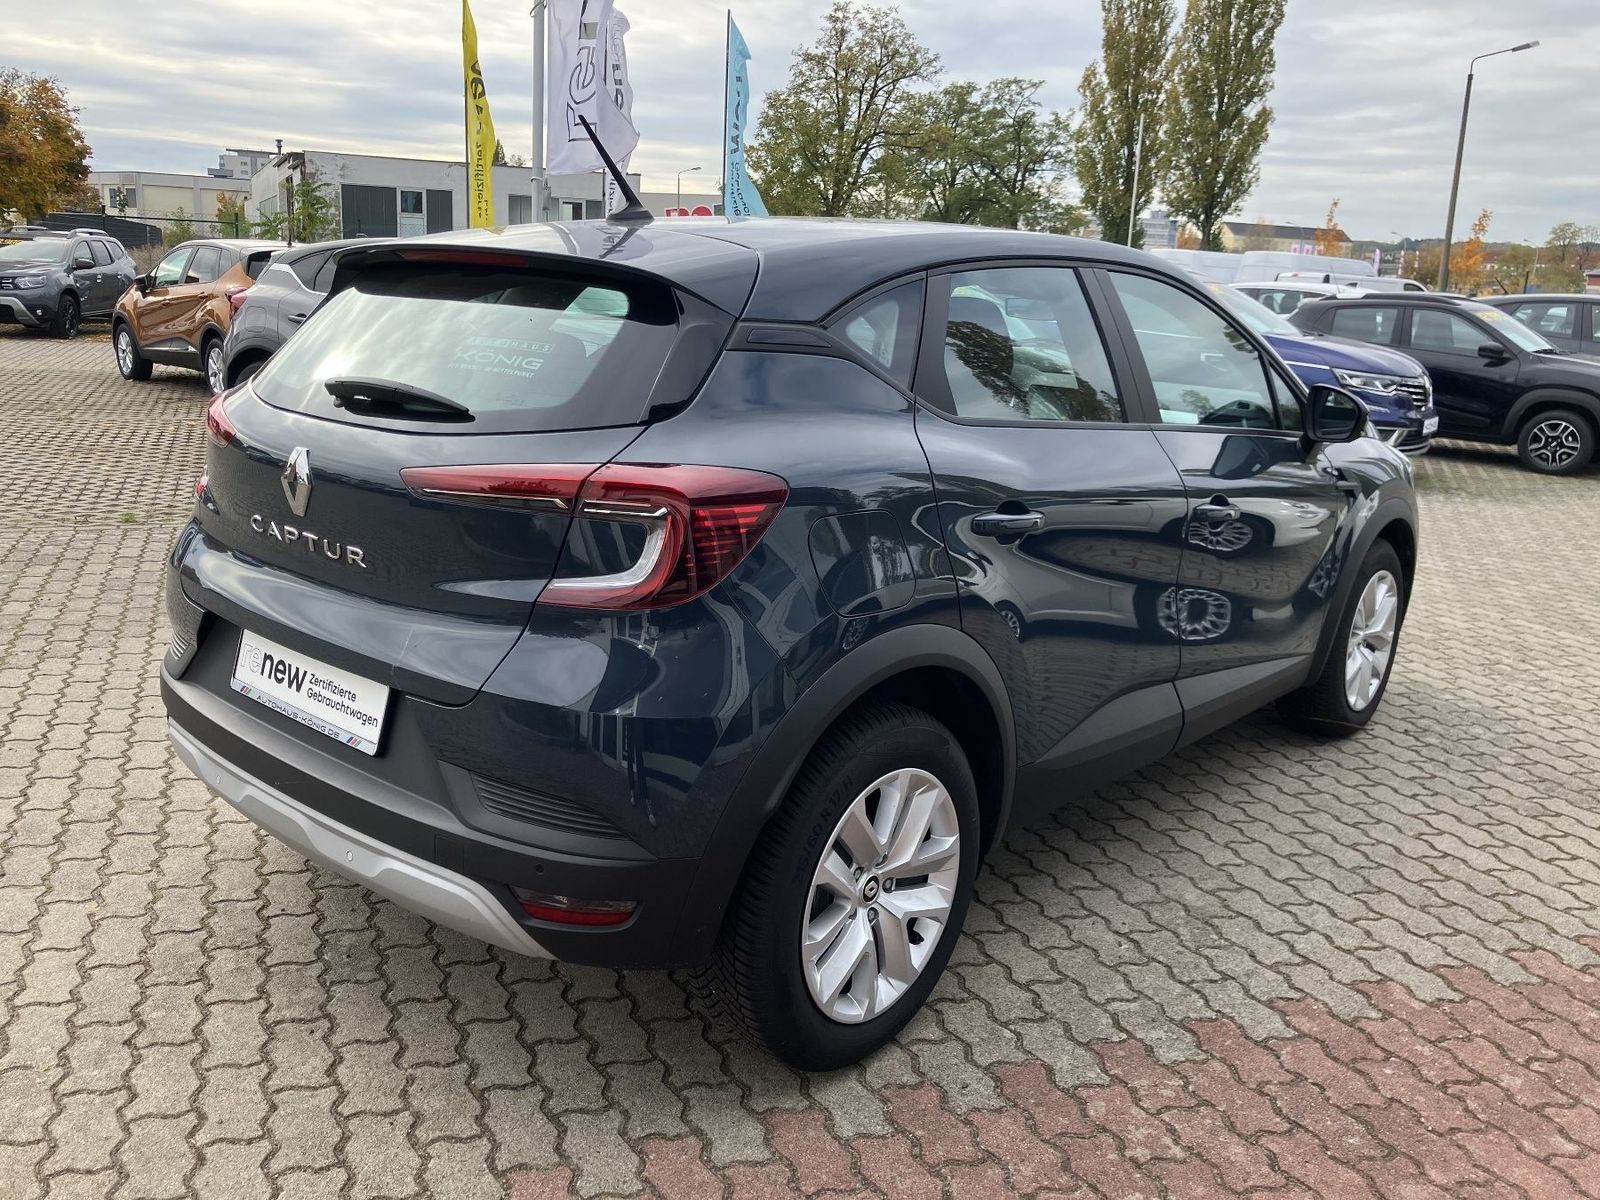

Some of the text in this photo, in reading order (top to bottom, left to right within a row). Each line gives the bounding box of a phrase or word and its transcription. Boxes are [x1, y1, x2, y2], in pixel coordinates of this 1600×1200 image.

[454, 347, 544, 370] KÖNIG
[250, 514, 367, 568] CAPTUR
[240, 643, 308, 693] renew
[308, 673, 357, 702] Zertifizierte
[306, 688, 378, 728] Gebrauchtwagen
